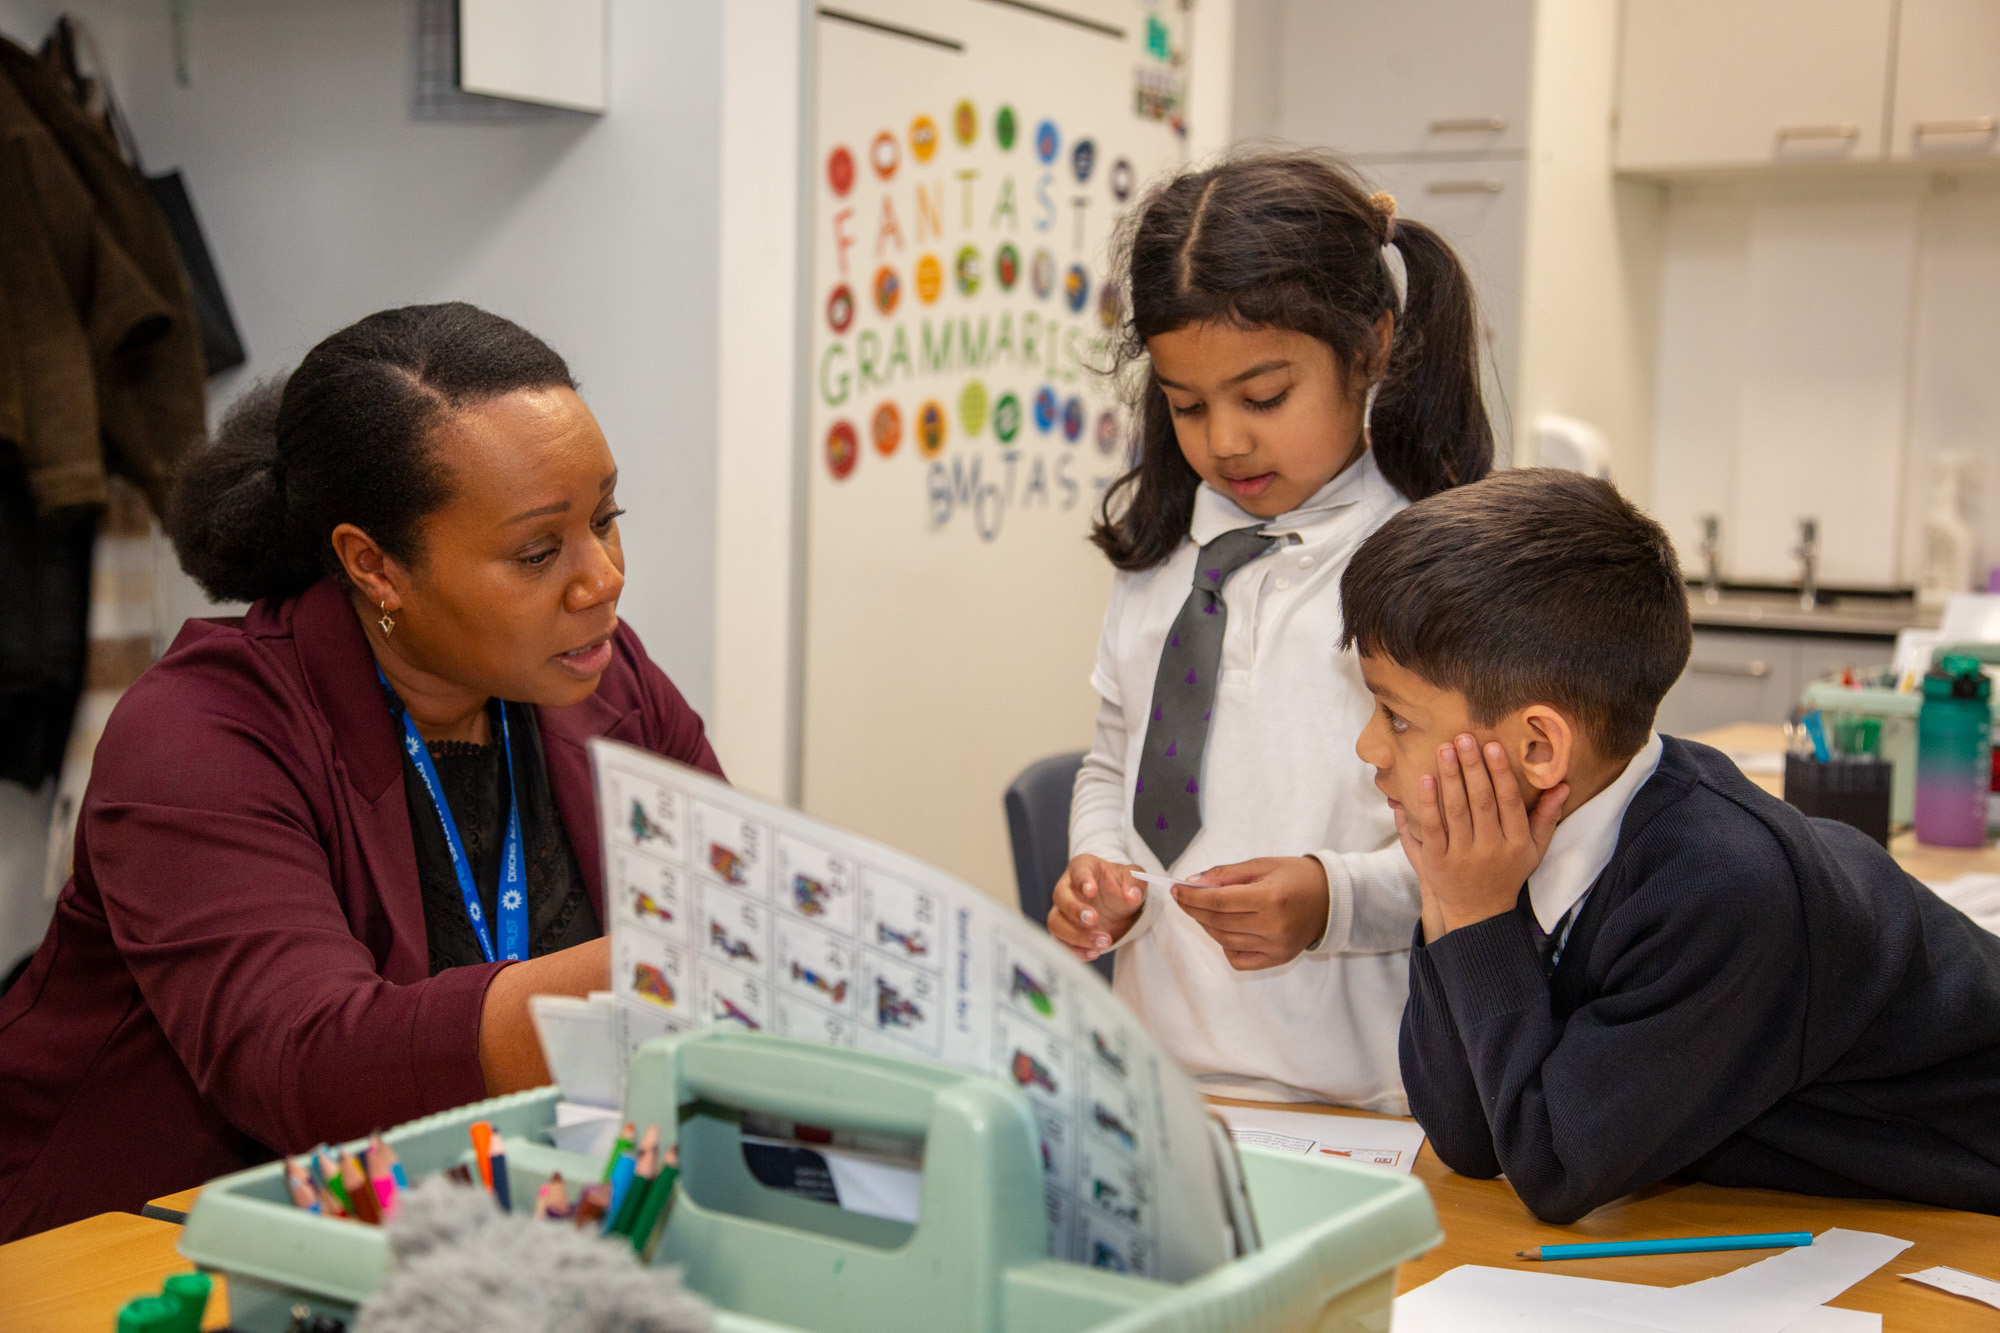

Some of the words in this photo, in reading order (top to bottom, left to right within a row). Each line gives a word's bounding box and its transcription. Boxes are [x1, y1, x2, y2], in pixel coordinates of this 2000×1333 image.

[832, 168, 1092, 276] FANTAST
[507, 842, 518, 883] DIXONS
[506, 919, 519, 950] TRUST
